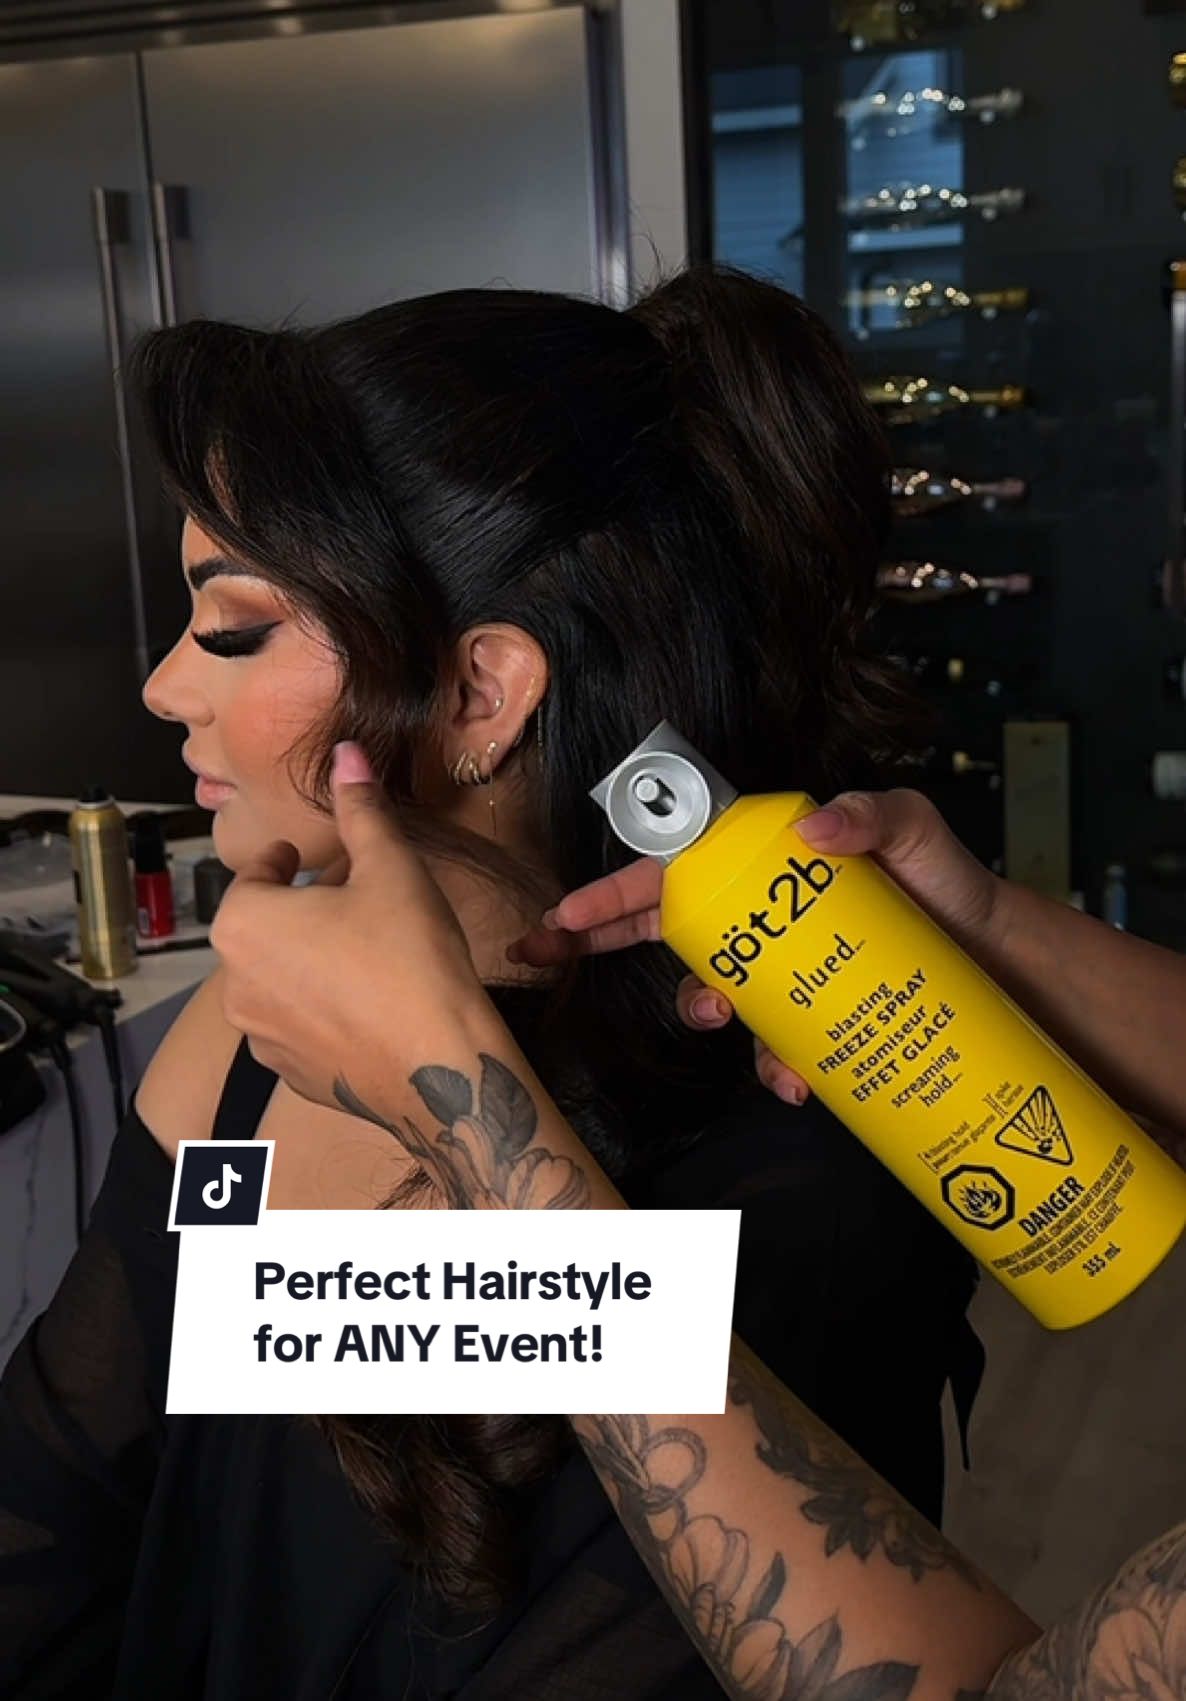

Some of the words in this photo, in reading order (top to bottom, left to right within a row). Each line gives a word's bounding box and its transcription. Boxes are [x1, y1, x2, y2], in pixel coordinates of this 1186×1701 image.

[817, 1022, 880, 1075] FREEZE
[876, 967, 928, 1026] SPRAY
[825, 981, 894, 1043] blasting
[851, 1004, 928, 1080] atomiseur
[851, 1058, 902, 1103] EFFET
[902, 1001, 956, 1063] GLACÉ
[891, 1045, 961, 1109] screaming
[1018, 1175, 1085, 1238] DANGER
[1082, 1254, 1107, 1277] 355
